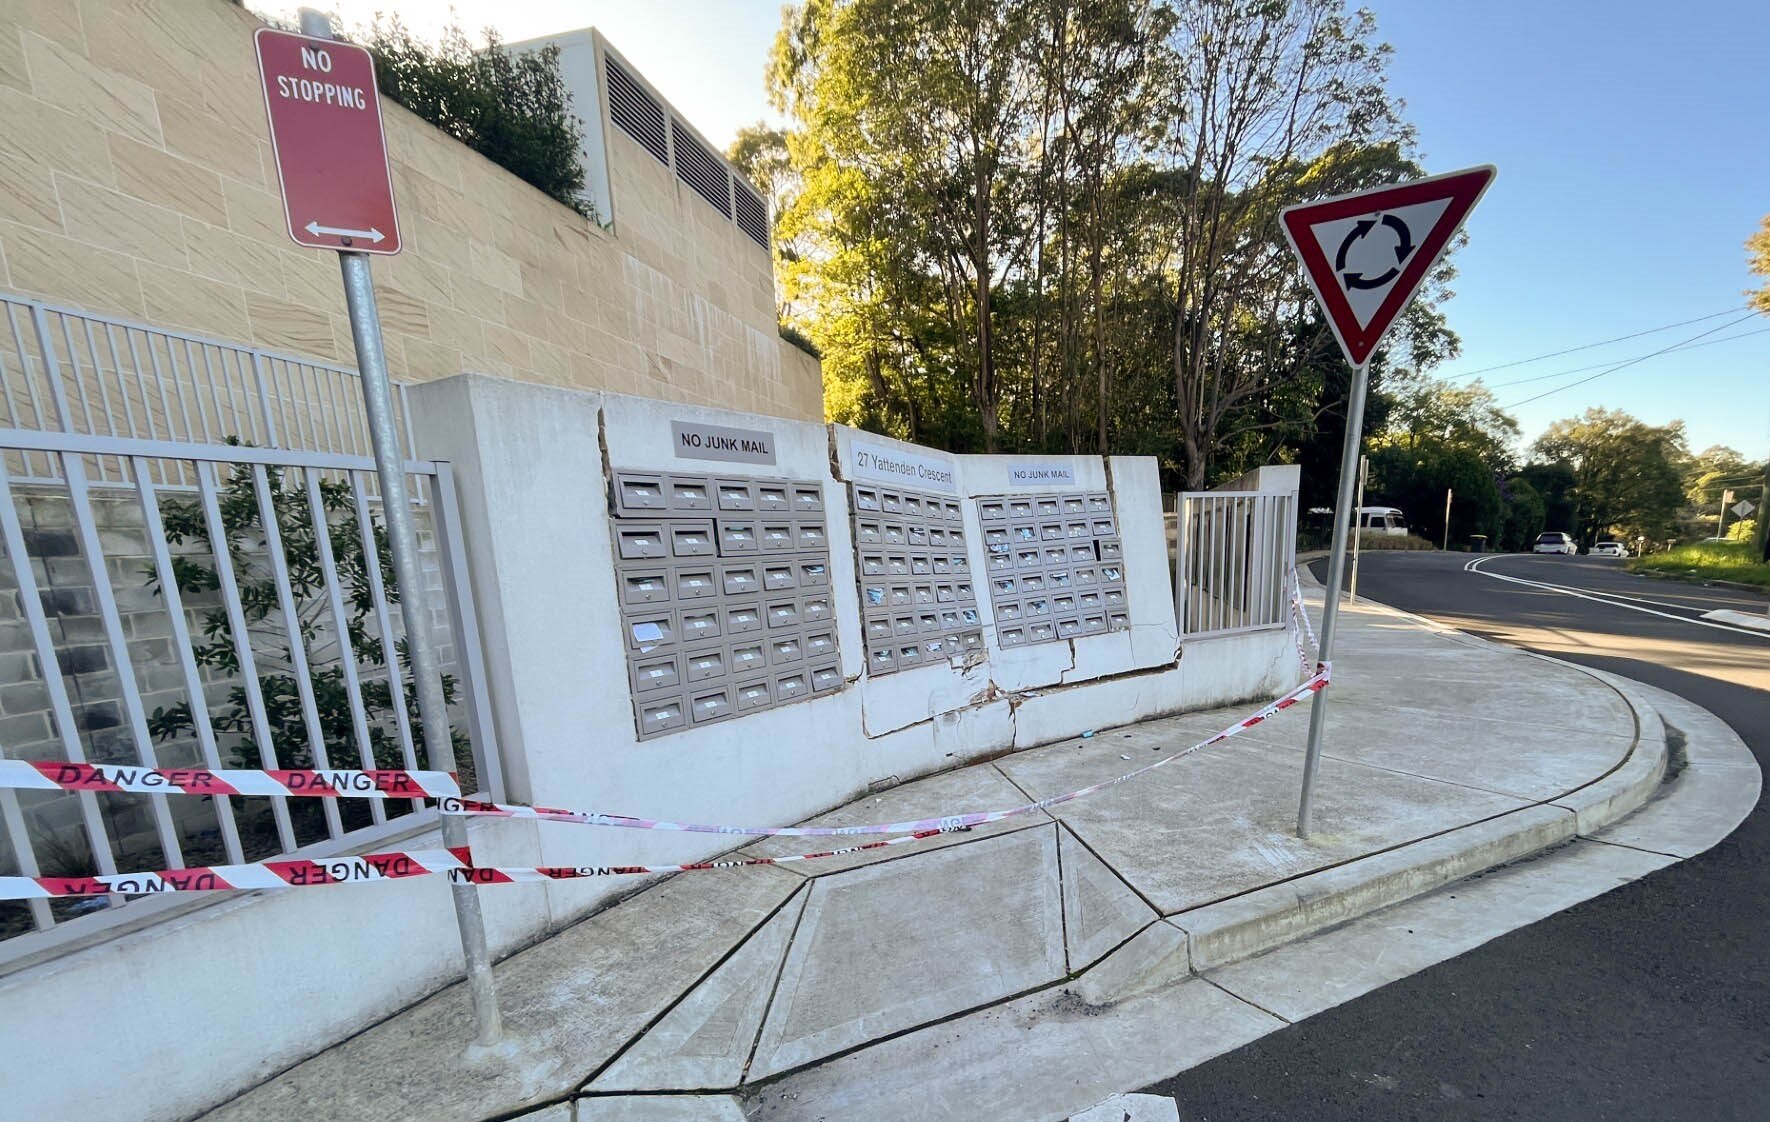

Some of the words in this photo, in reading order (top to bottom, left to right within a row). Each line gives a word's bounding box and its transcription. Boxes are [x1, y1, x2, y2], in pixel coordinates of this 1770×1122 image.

[301, 47, 332, 73] NO
[277, 75, 366, 110] STOPPING
[681, 432, 701, 448] NO
[705, 436, 738, 451] JUNK
[741, 439, 769, 454] MAIL
[857, 451, 869, 468] 27
[872, 455, 916, 476] Yattenden
[918, 464, 952, 484] Crescent
[1014, 470, 1027, 479] NO
[1028, 470, 1049, 479] JUNK
[1051, 470, 1070, 479] MAIL
[56, 765, 213, 788] DANGER
[287, 772, 410, 792] DANGER
[289, 857, 409, 886] DANGER
